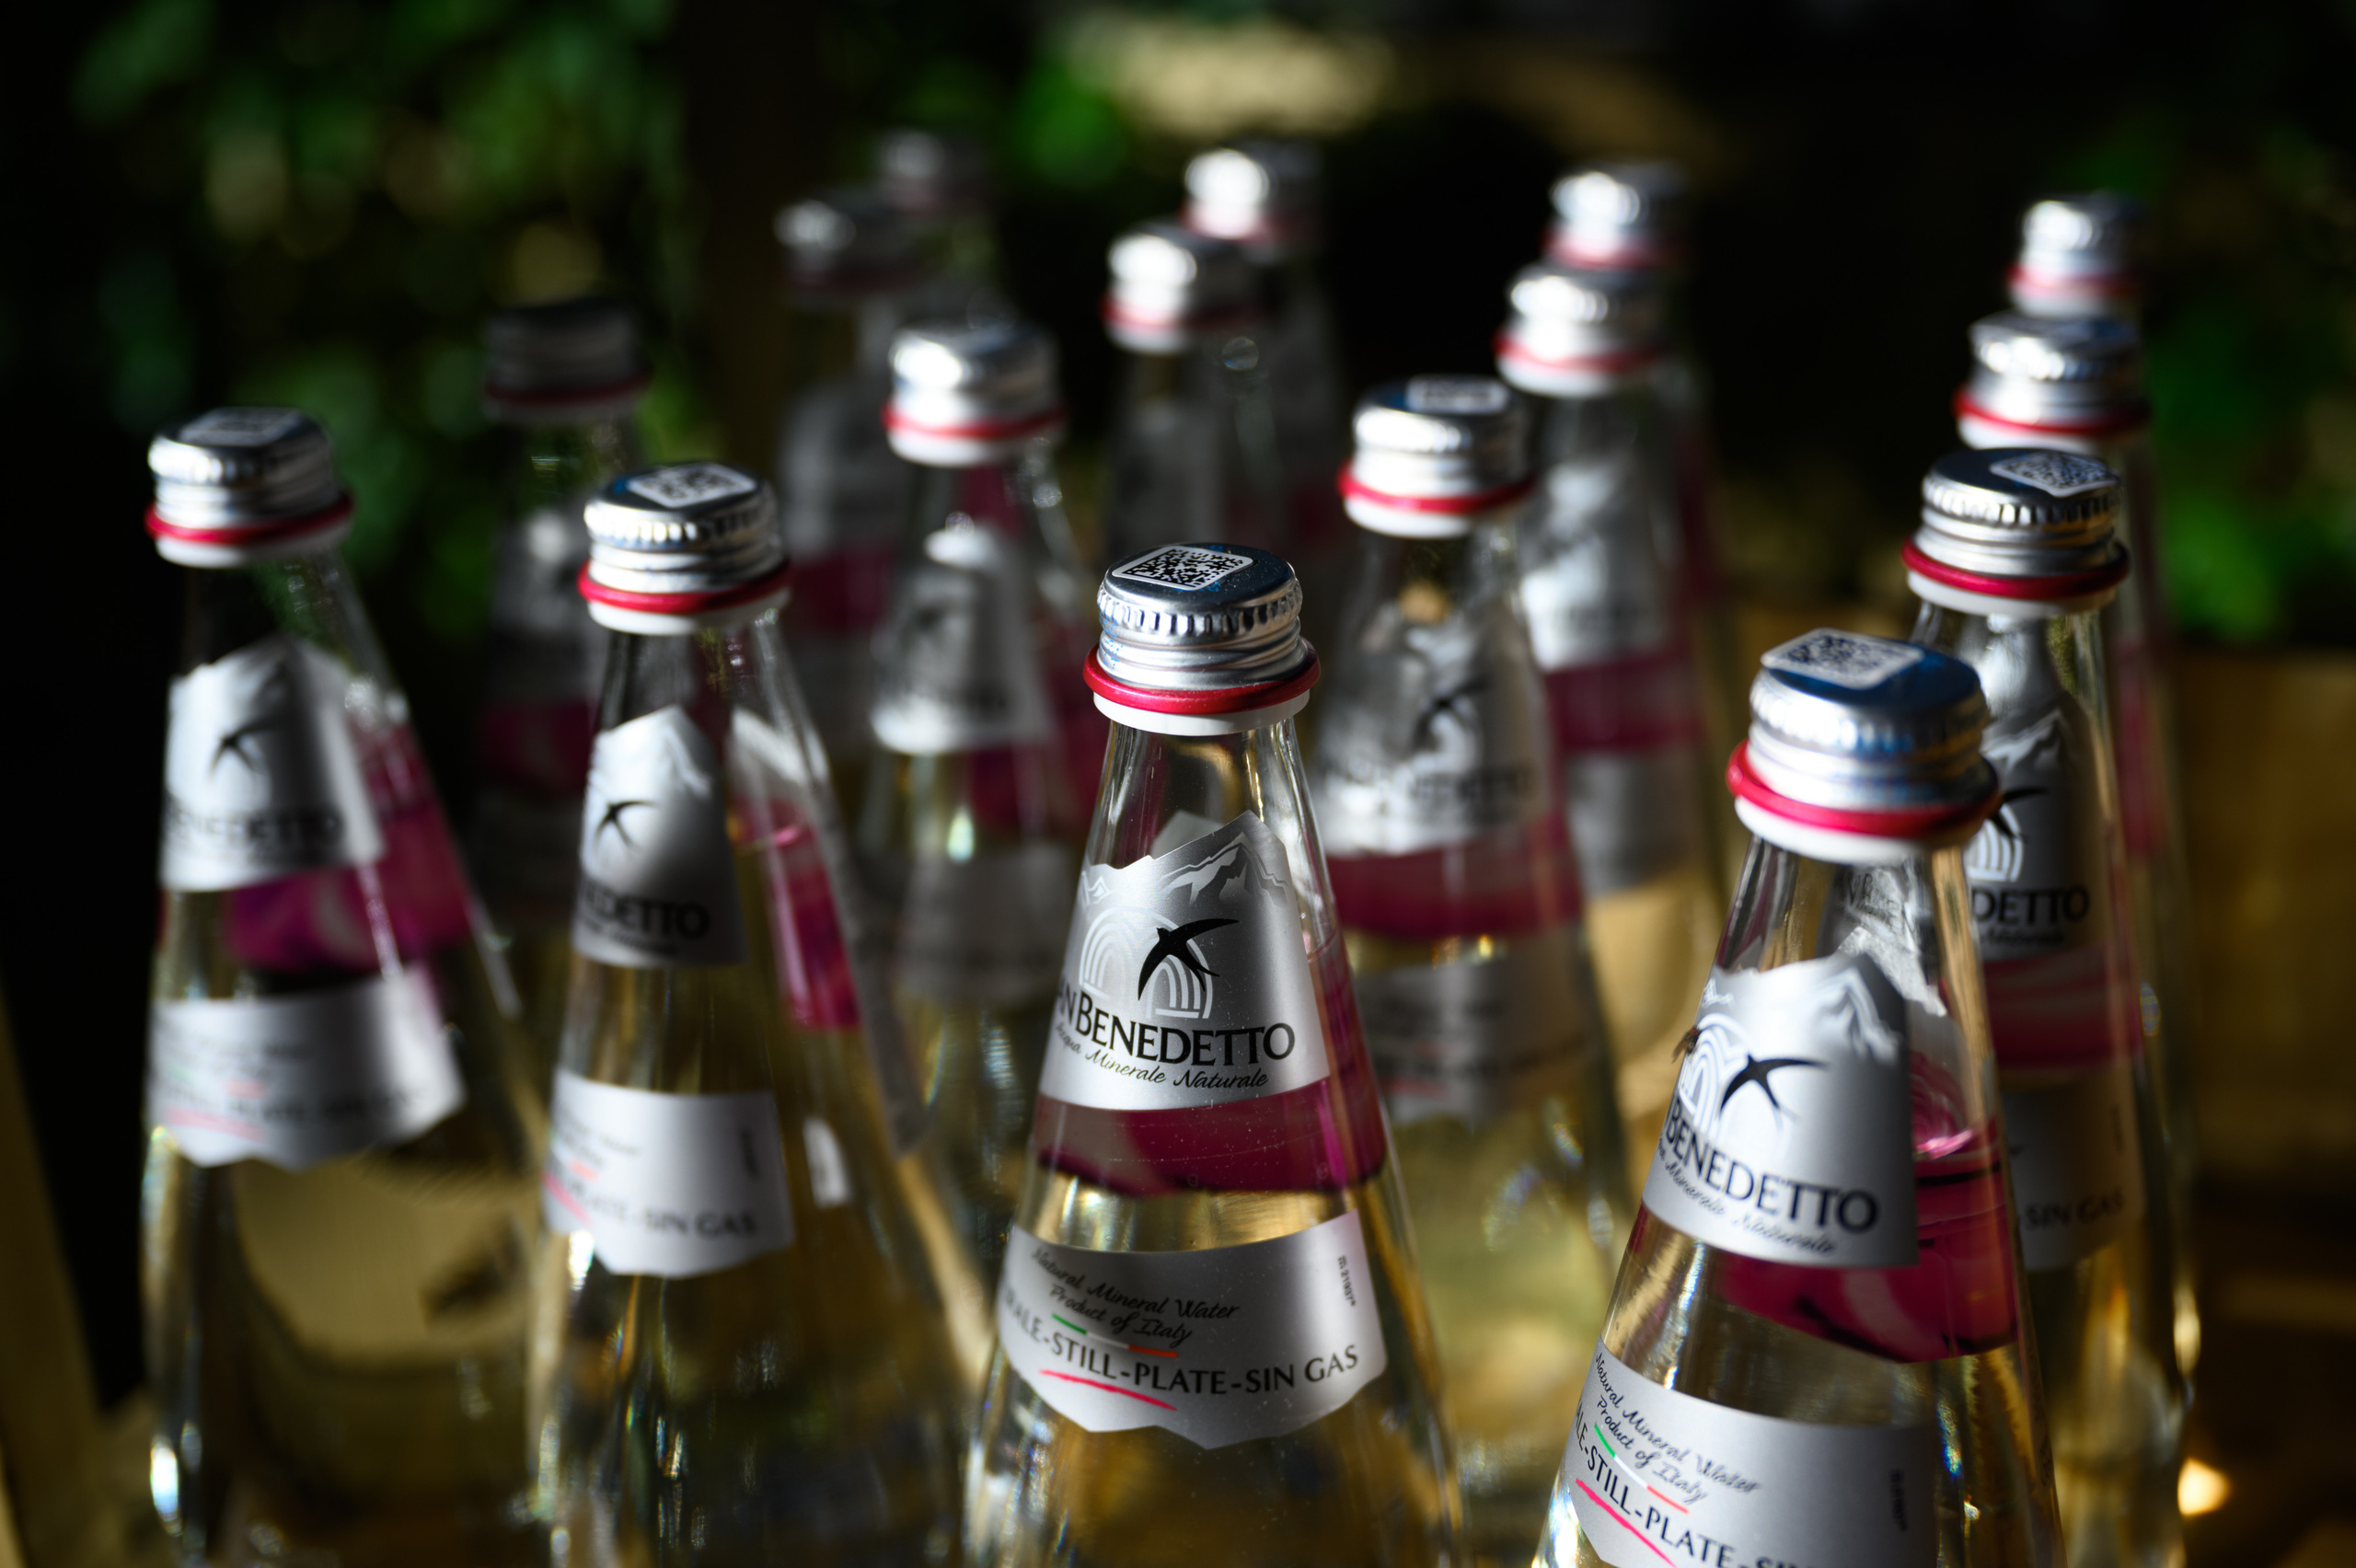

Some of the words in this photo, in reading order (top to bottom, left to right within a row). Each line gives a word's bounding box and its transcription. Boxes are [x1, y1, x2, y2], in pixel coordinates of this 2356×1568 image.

[1086, 1049, 1167, 1084] Minerale
[1173, 1067, 1269, 1090] Naturale
[1032, 1247, 1086, 1289] Natural
[1087, 1282, 1169, 1316] Mineral
[1174, 1298, 1241, 1320] Water
[1050, 1284, 1107, 1322] Product
[1110, 1309, 1140, 1334] of
[1133, 1315, 1194, 1348] Italy
[1305, 1343, 1358, 1382] GAS
[1595, 1352, 1624, 1409] Natural
[1623, 1410, 1692, 1462] Mineral
[1597, 1394, 1635, 1450] Product
[1634, 1450, 1662, 1470] of
[1652, 1461, 1709, 1506] Italy
